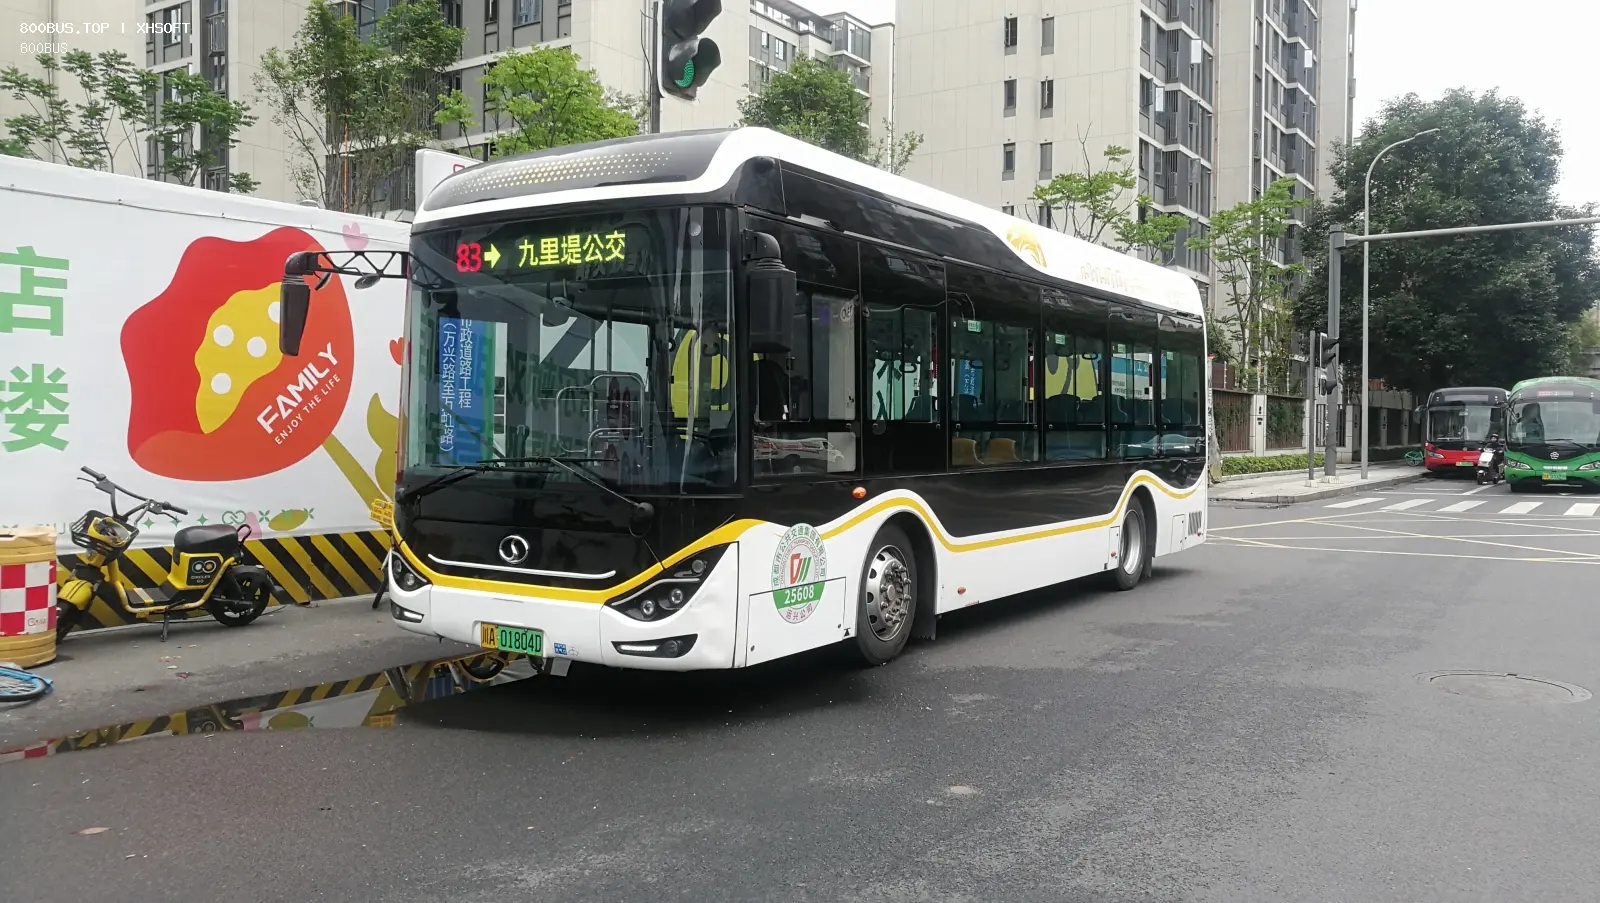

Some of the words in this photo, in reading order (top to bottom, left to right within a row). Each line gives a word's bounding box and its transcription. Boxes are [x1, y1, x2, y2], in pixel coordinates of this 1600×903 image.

[456, 243, 482, 273] 83
[518, 230, 626, 268] 九里堤公交
[0, 246, 69, 336] 店
[256, 342, 338, 434] FAMILY
[274, 413, 304, 445] ENJOY
[302, 394, 322, 414] THE
[320, 373, 341, 396] LIFE
[784, 585, 815, 605] 25608
[500, 630, 541, 652] 01804D
